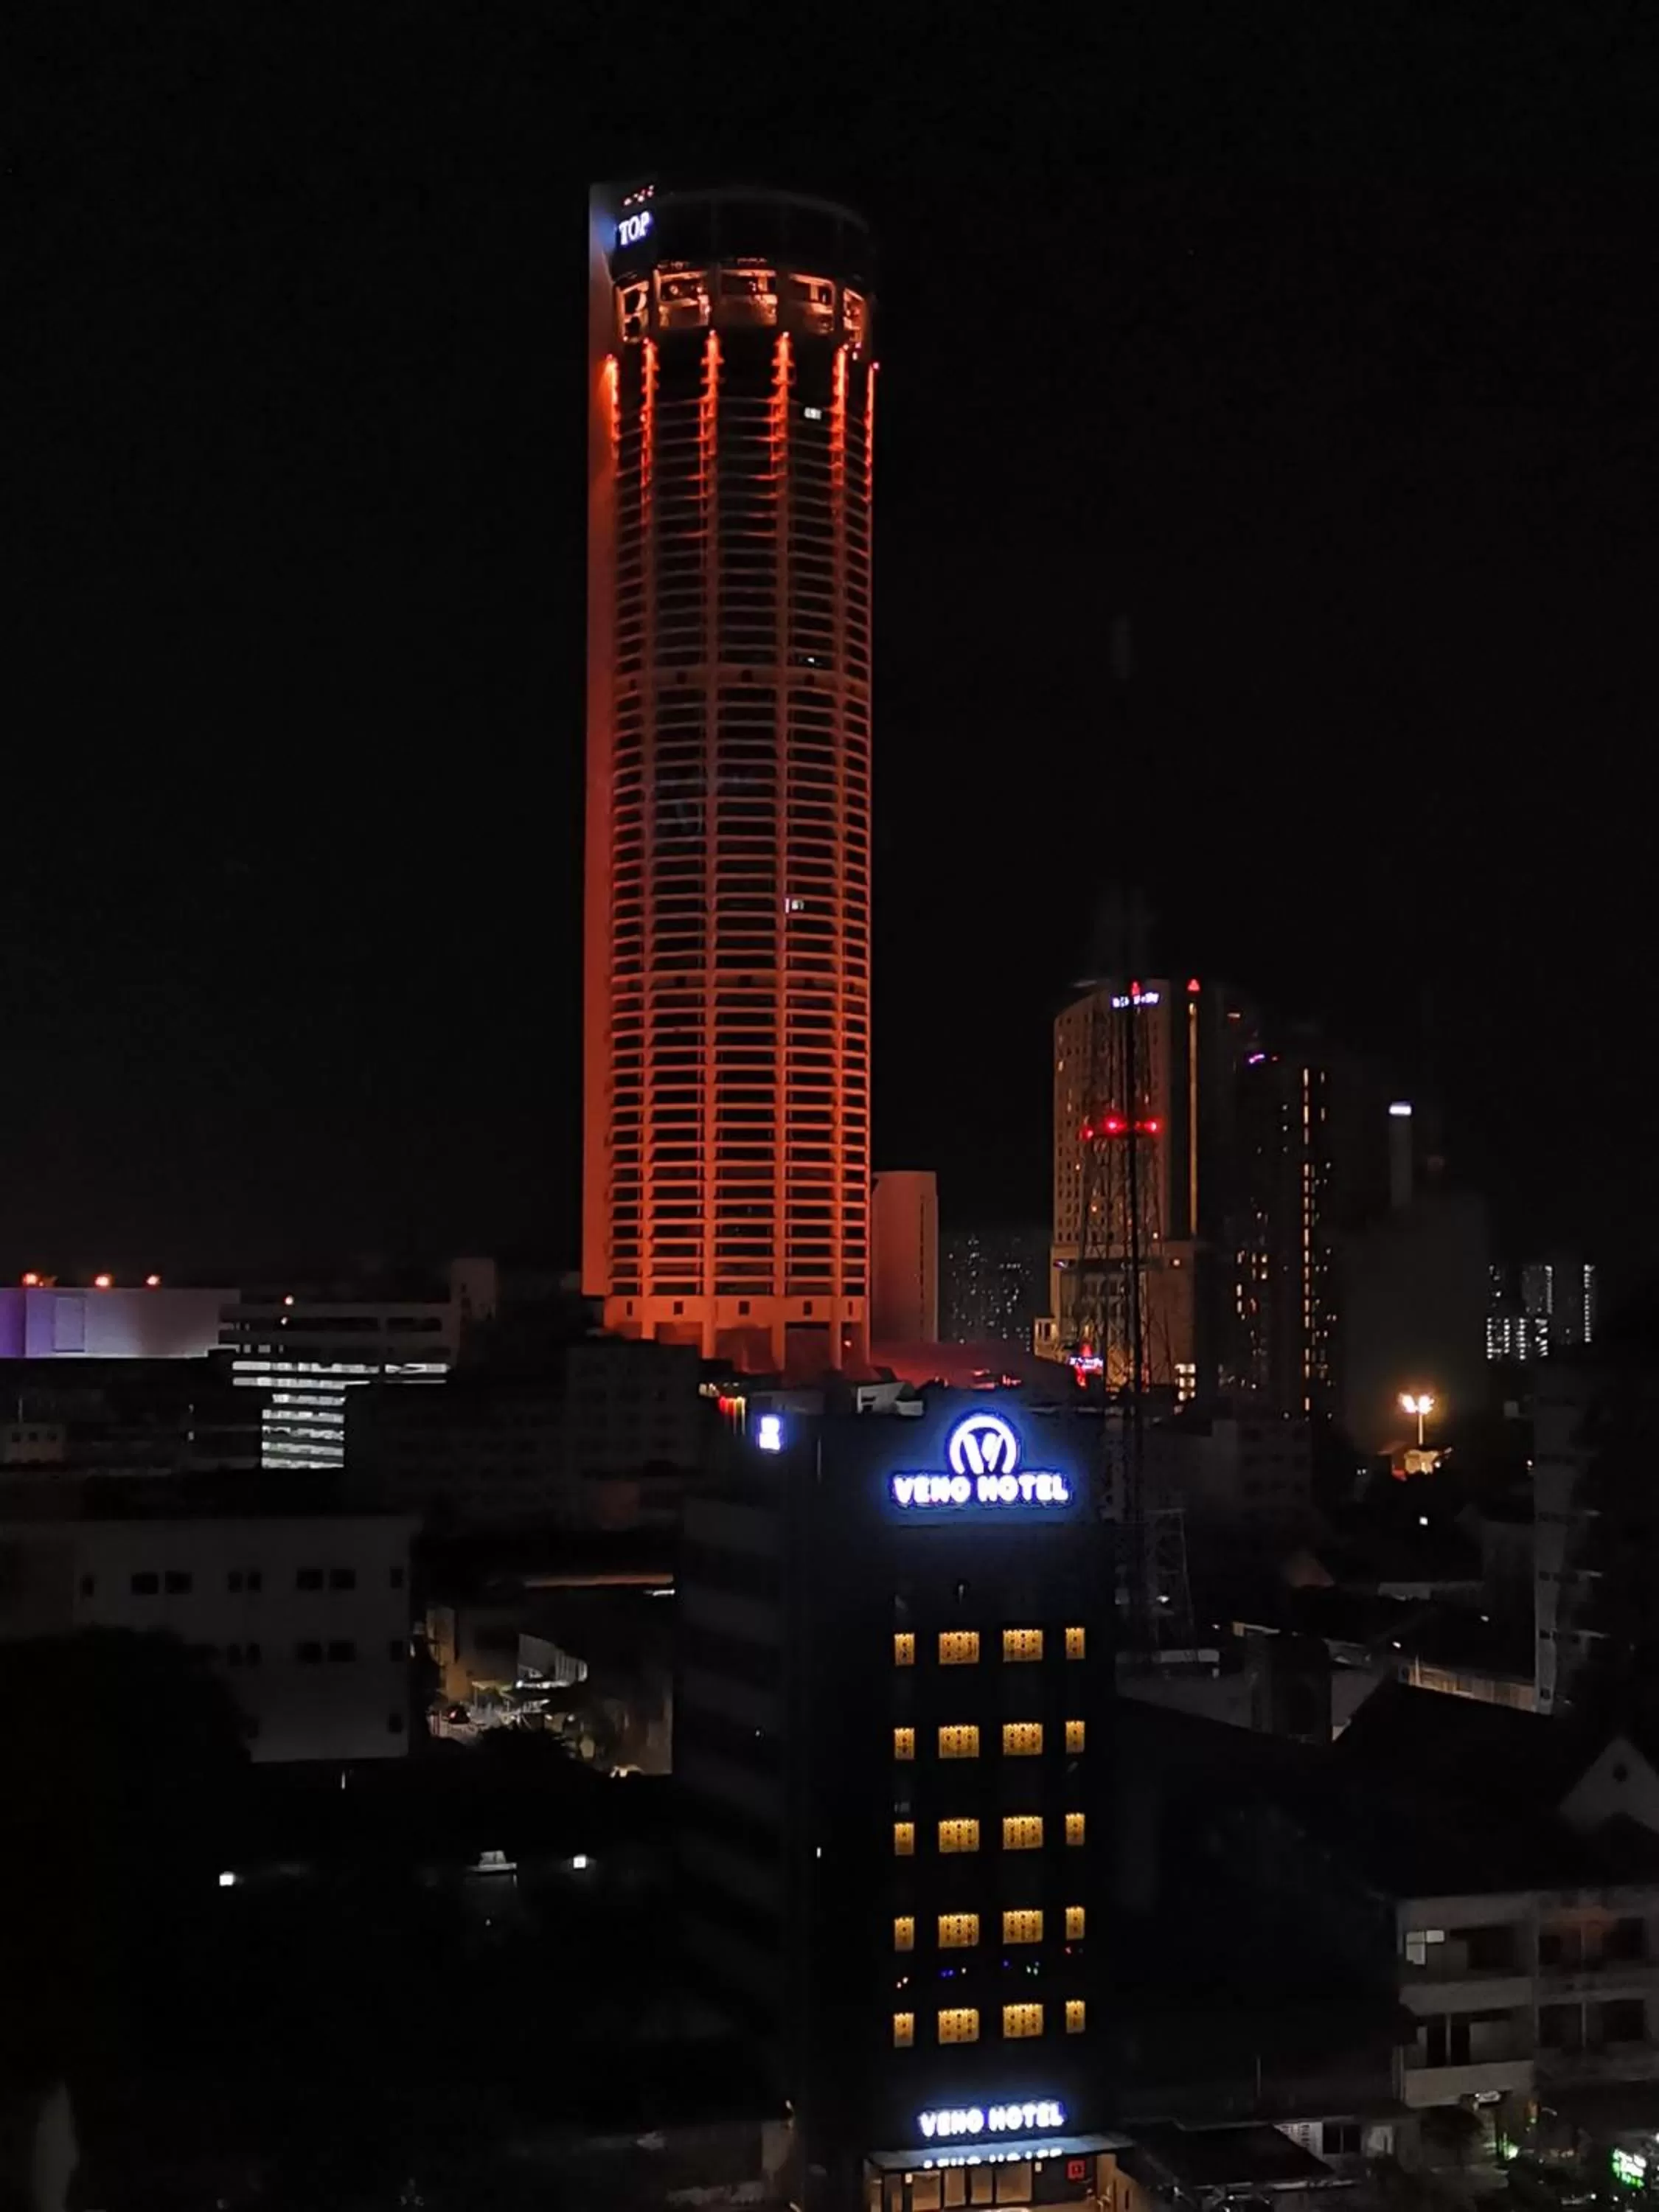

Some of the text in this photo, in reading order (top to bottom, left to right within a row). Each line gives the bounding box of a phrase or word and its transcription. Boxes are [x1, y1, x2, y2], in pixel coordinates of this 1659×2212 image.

[619, 211, 651, 246] TOP
[894, 1474, 1069, 1504] VENO HOTEL
[987, 2102, 1064, 2132] HOTEL
